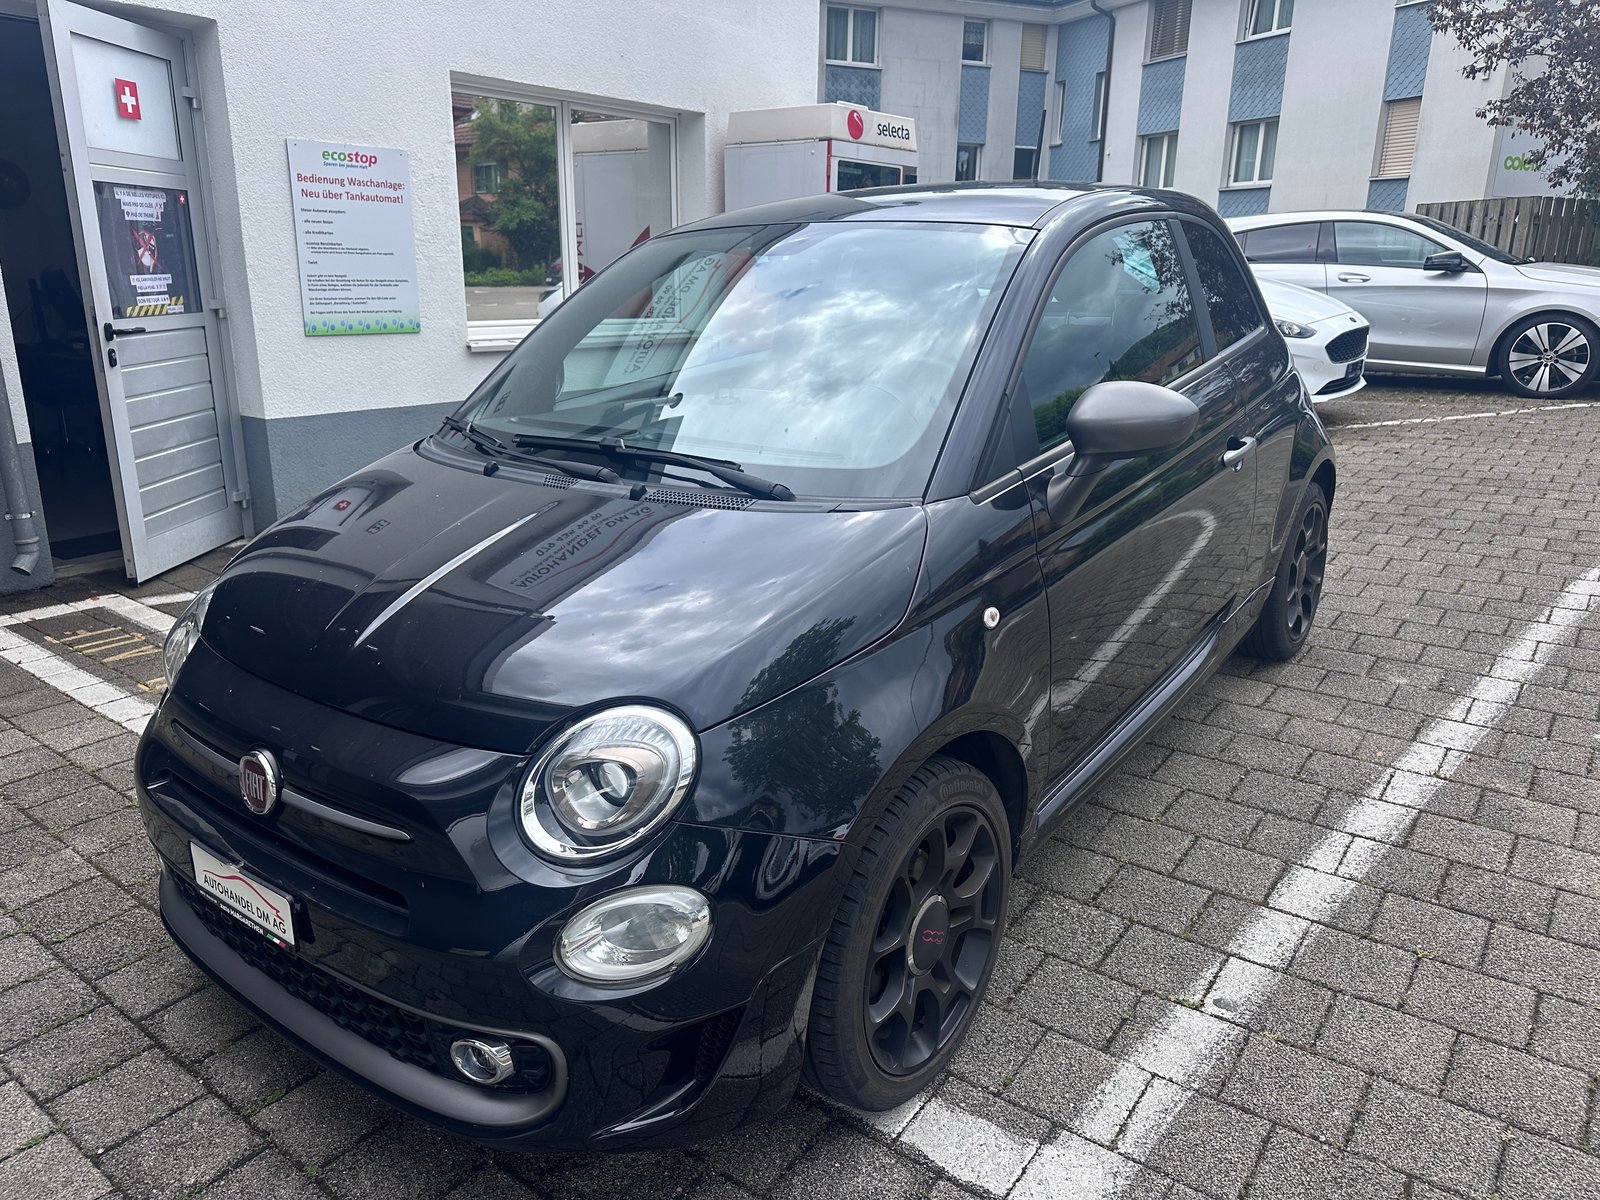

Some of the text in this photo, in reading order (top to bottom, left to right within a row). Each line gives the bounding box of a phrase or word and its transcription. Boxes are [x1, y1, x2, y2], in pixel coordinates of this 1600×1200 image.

[876, 122, 910, 140] selecta
[322, 150, 378, 167] ecostop
[296, 172, 406, 191] Bedienung Waschanlage:
[301, 188, 404, 204] Neu über Tankautomat!
[246, 768, 265, 801] FIAT
[940, 780, 983, 800] Continental
[204, 874, 255, 915] AUTOHANDEL
[256, 906, 271, 925] DM
[273, 918, 286, 934] AG
